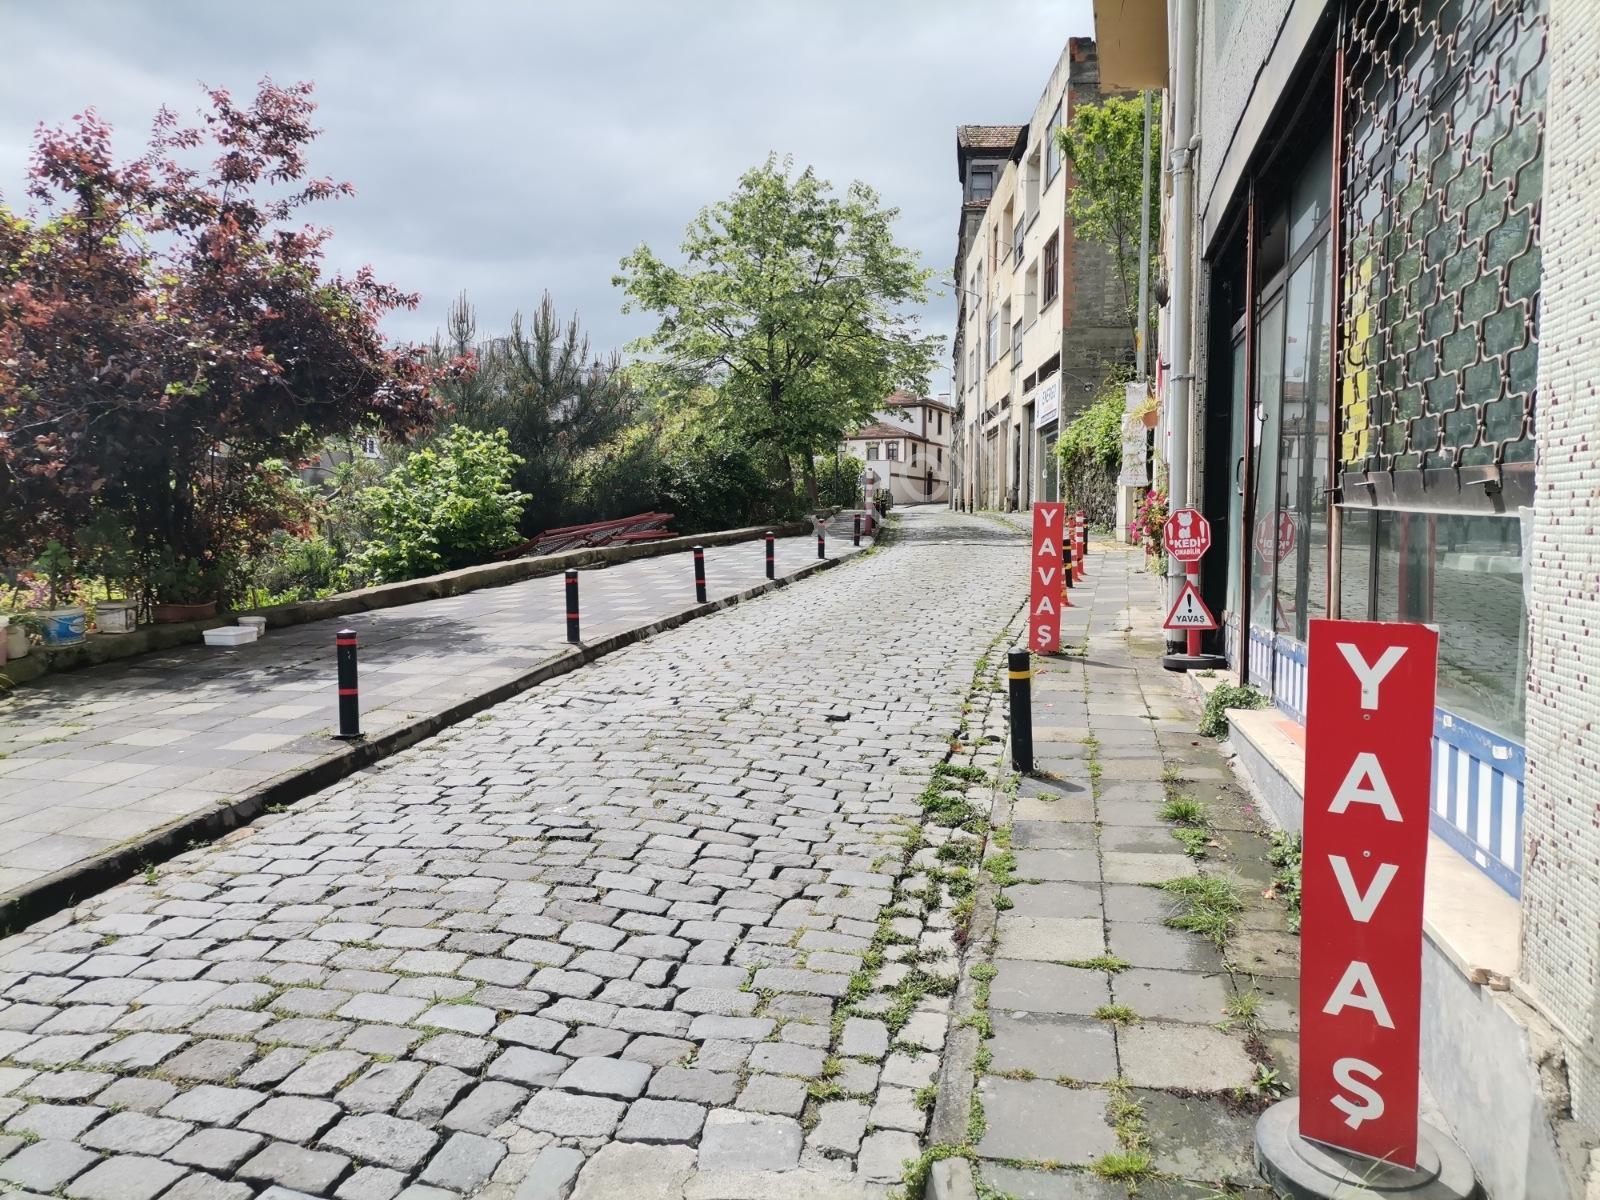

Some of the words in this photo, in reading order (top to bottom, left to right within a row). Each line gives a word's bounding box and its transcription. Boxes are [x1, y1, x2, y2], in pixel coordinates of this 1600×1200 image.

[1036, 508, 1058, 647] YAVAŞ
[1174, 537, 1201, 548] KEDİ
[1176, 615, 1205, 624] YAVAŞ
[1322, 642, 1408, 1130] YAVAŞ
